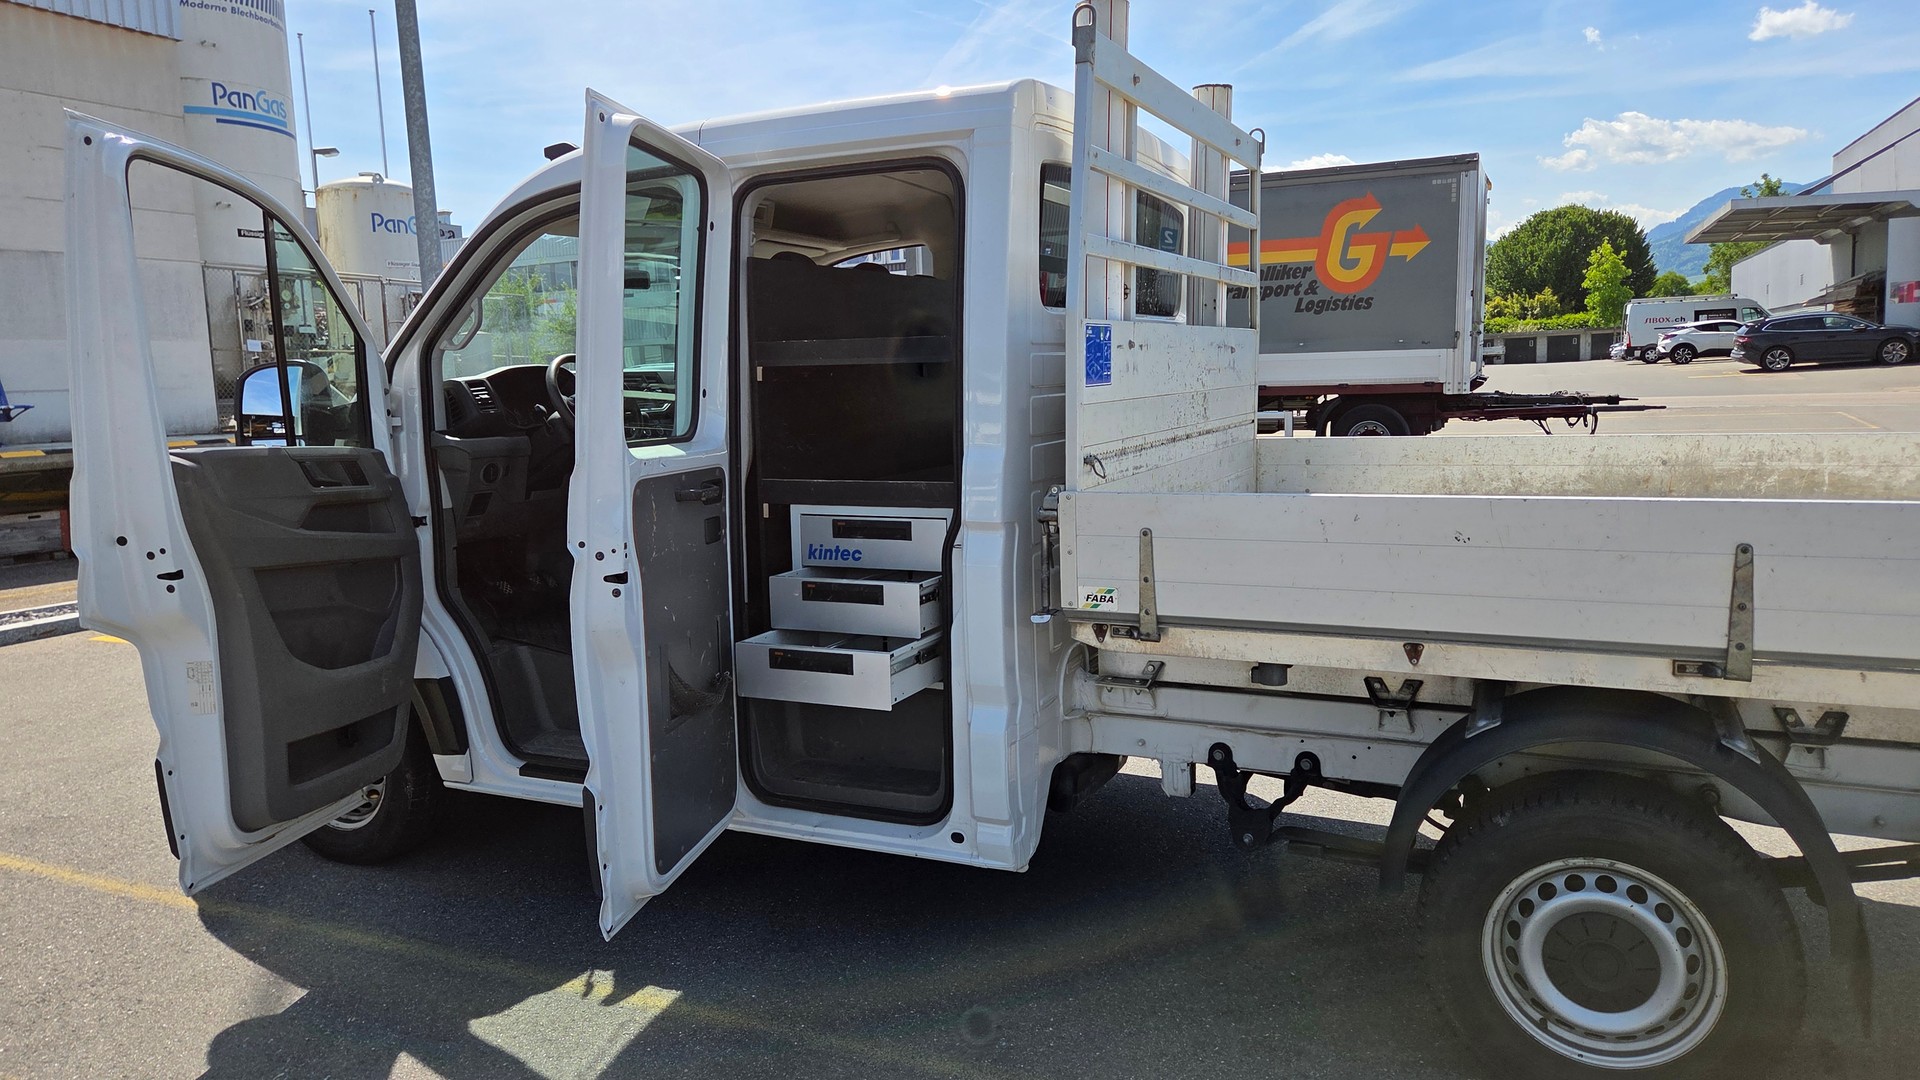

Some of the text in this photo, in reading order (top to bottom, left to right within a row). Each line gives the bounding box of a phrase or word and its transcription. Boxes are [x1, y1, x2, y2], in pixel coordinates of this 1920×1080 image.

[179, 0, 227, 12] Moderne
[211, 82, 287, 119] PanGas
[371, 212, 417, 235] PanG
[1227, 279, 1320, 301] ranport &
[1294, 295, 1374, 315] Logistics
[808, 543, 863, 562] kintec
[1085, 594, 1114, 603] FABA
